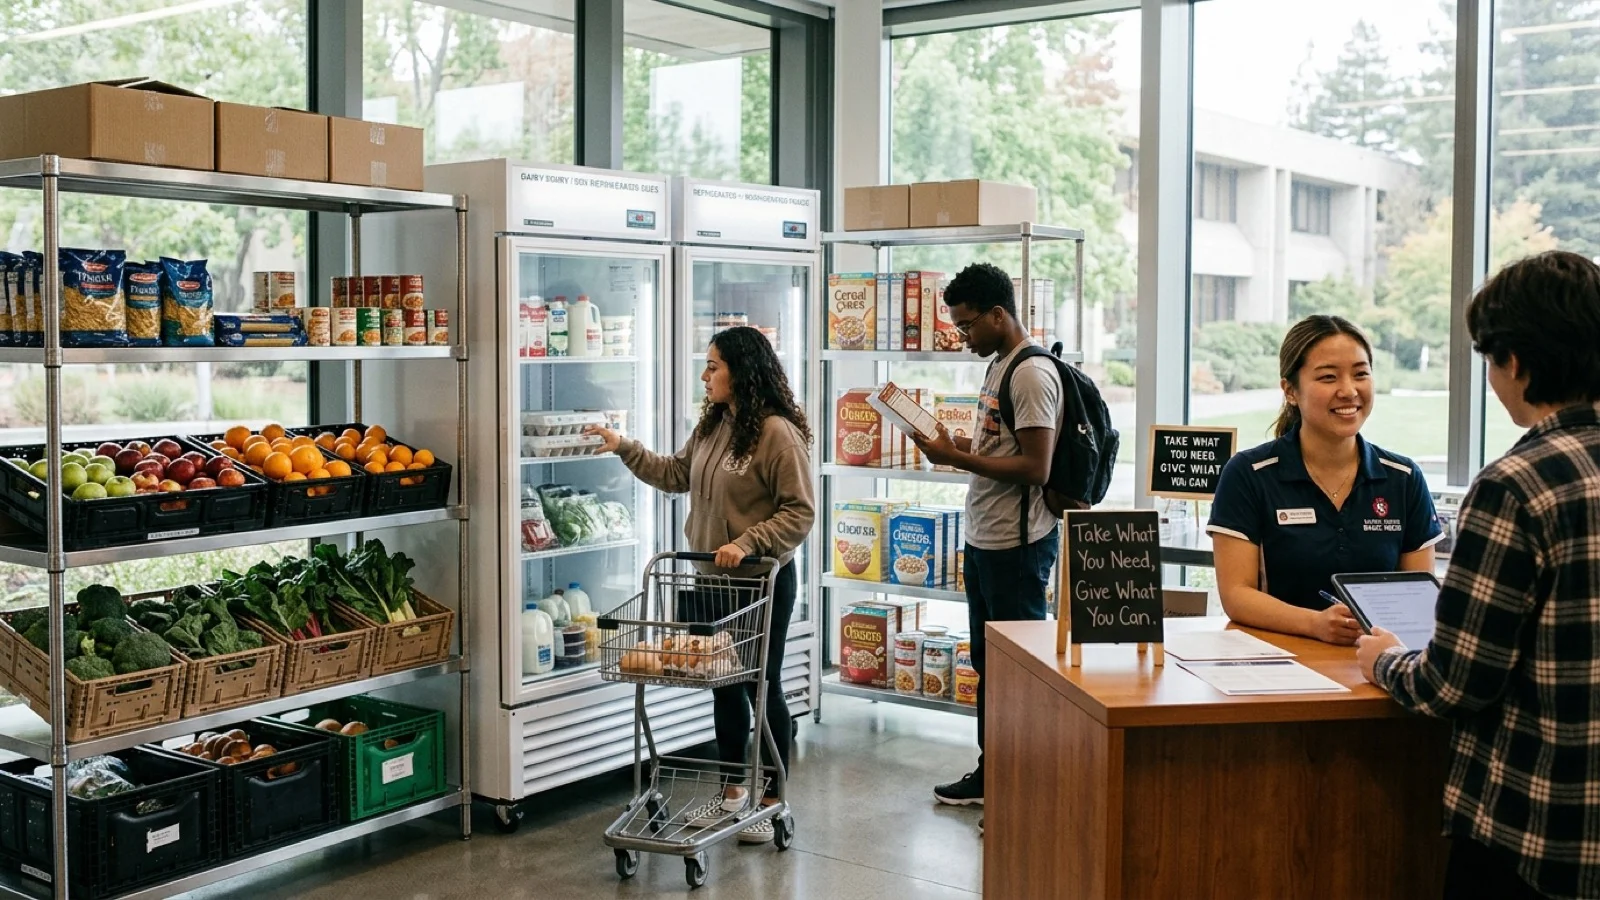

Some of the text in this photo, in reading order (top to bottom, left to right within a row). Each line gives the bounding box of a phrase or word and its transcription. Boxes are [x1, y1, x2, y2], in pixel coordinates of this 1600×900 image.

[1164, 436, 1220, 447] TAKE WHAT
[1072, 522, 1157, 544] Take What
[1077, 549, 1156, 572] You Need,
[1075, 580, 1157, 601] Give What
[1086, 605, 1157, 628] You Can.
